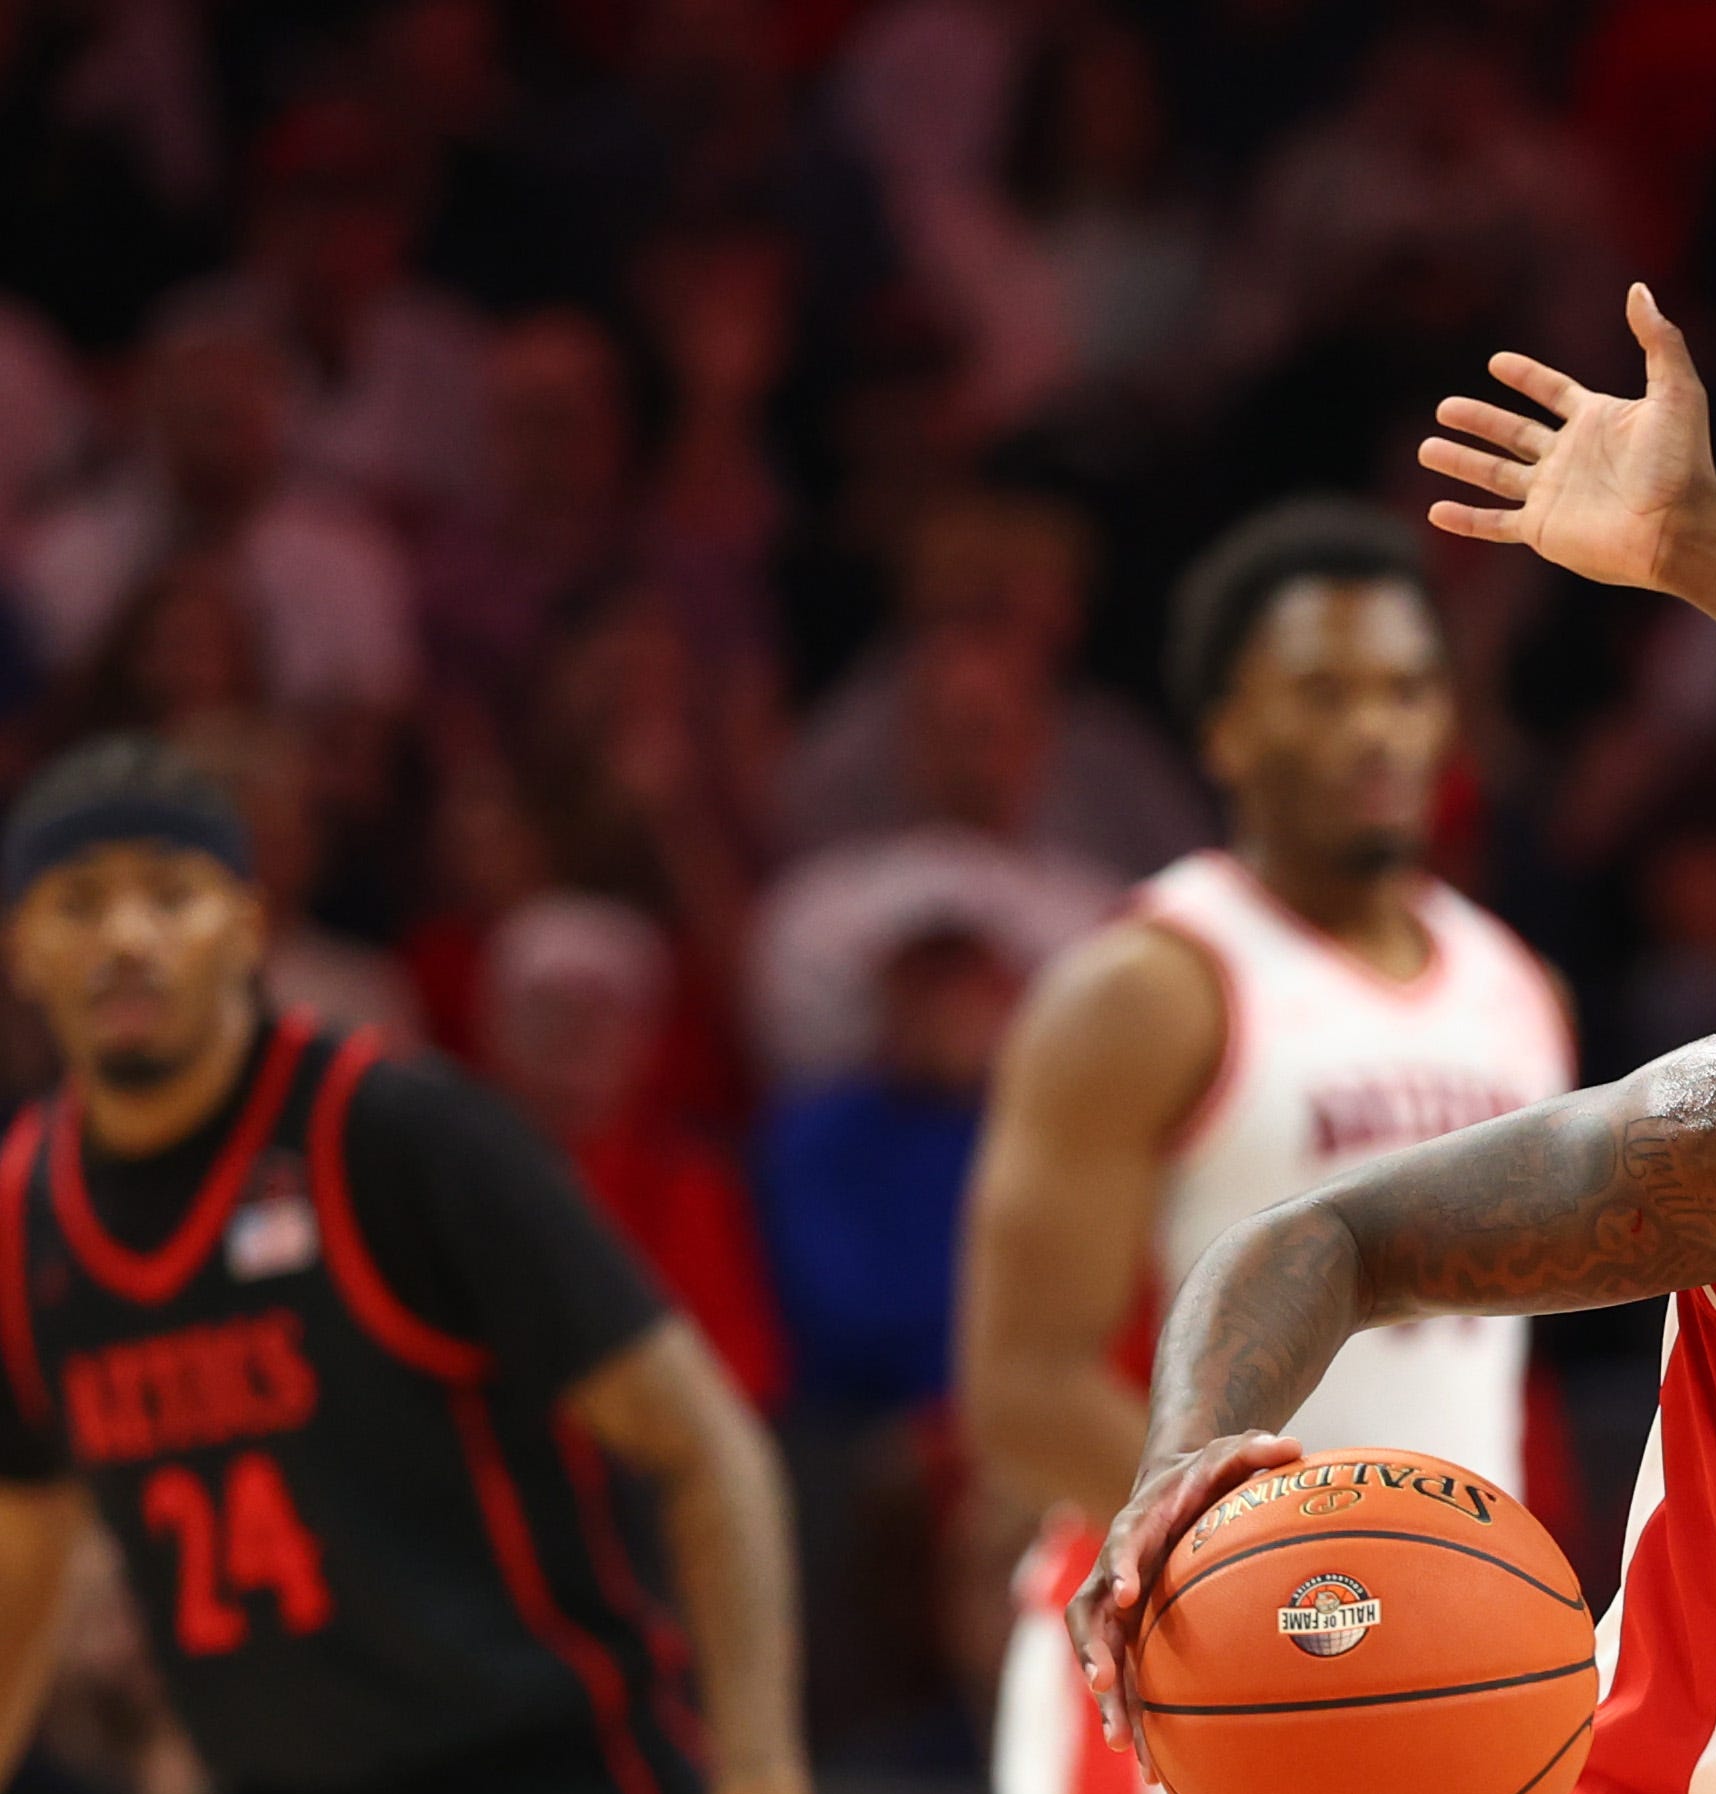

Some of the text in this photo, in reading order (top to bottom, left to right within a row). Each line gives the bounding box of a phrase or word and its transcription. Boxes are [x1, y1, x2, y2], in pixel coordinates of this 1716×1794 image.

[1192, 1463, 1496, 1552] SPALDING
[140, 1448, 335, 1658] 24
[1281, 1603, 1376, 1631] HALL OF FAME
